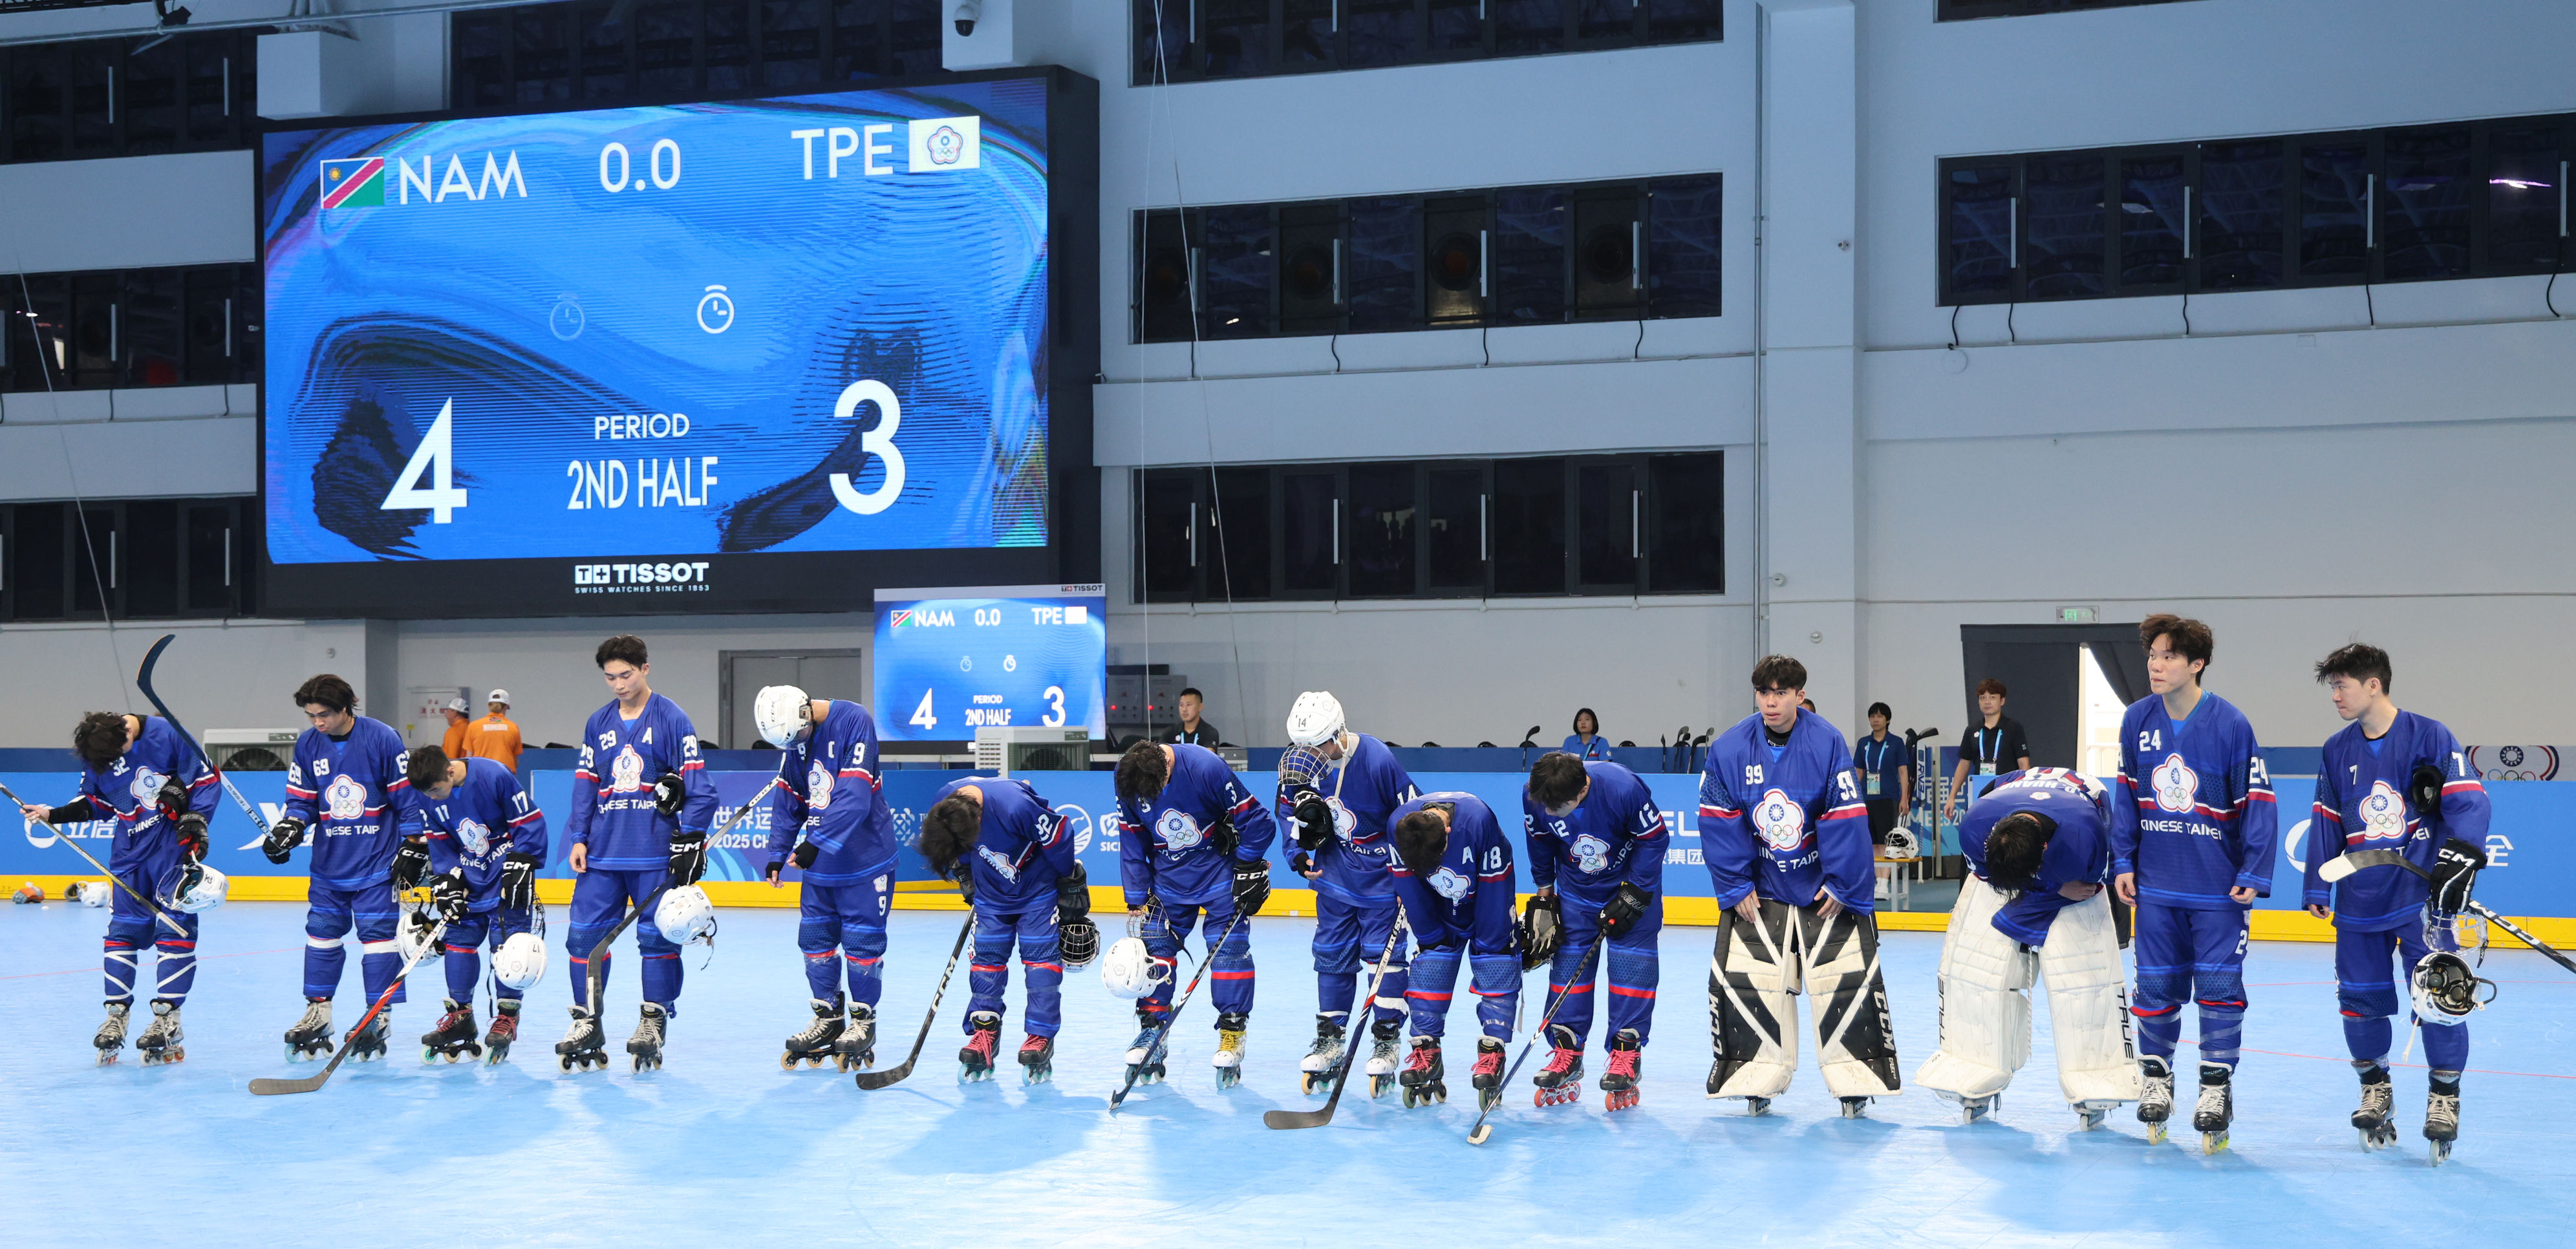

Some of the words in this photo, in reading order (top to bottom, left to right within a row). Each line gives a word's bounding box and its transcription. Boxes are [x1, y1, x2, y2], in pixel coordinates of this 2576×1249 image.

[790, 123, 894, 181] TPE
[399, 149, 528, 205] NAM
[599, 138, 682, 193] 0.0
[594, 413, 690, 440] PERIOD
[828, 379, 906, 515] 3
[380, 396, 467, 524] 4
[566, 459, 628, 511] 2ND
[637, 456, 718, 508] HALF
[612, 562, 709, 583] TISSOT
[914, 610, 955, 626] NAM
[974, 608, 1001, 626] 0.0
[1031, 607, 1062, 625] TPE
[908, 688, 937, 730] 4
[973, 694, 1003, 704] PERIOD
[1042, 686, 1066, 727] 3
[965, 709, 985, 726] 2ND
[986, 709, 1012, 726] HALF
[1297, 717, 1307, 728] 14
[599, 729, 617, 751] 29
[641, 727, 652, 745] A
[683, 734, 698, 758] 29
[2139, 729, 2162, 752] 24
[579, 743, 594, 769] 29
[852, 742, 866, 765] 9
[2451, 751, 2466, 776] 7
[288, 762, 302, 785] 69
[313, 758, 330, 776] 69
[1745, 763, 1765, 785] 99
[2249, 756, 2269, 785] 24
[2349, 764, 2358, 785] 7
[1225, 781, 1237, 803] 3
[1836, 770, 1858, 800] 99
[435, 804, 450, 822] 17
[511, 790, 530, 814] 17
[1638, 802, 1660, 828] 12
[1658, 810, 1701, 837] EL
[354, 824, 380, 835] TAIP
[1548, 819, 1569, 838] 12
[714, 833, 749, 849] 2025
[502, 860, 530, 871] CM
[1462, 846, 1474, 864] A
[1482, 846, 1502, 870] 18
[878, 895, 887, 916] 9
[2235, 929, 2249, 955] 2
[1873, 990, 1895, 1051] CCM
[1937, 977, 1946, 1045] TRUE
[1708, 992, 1723, 1056] CCM
[2117, 987, 2134, 1060] TRUE
